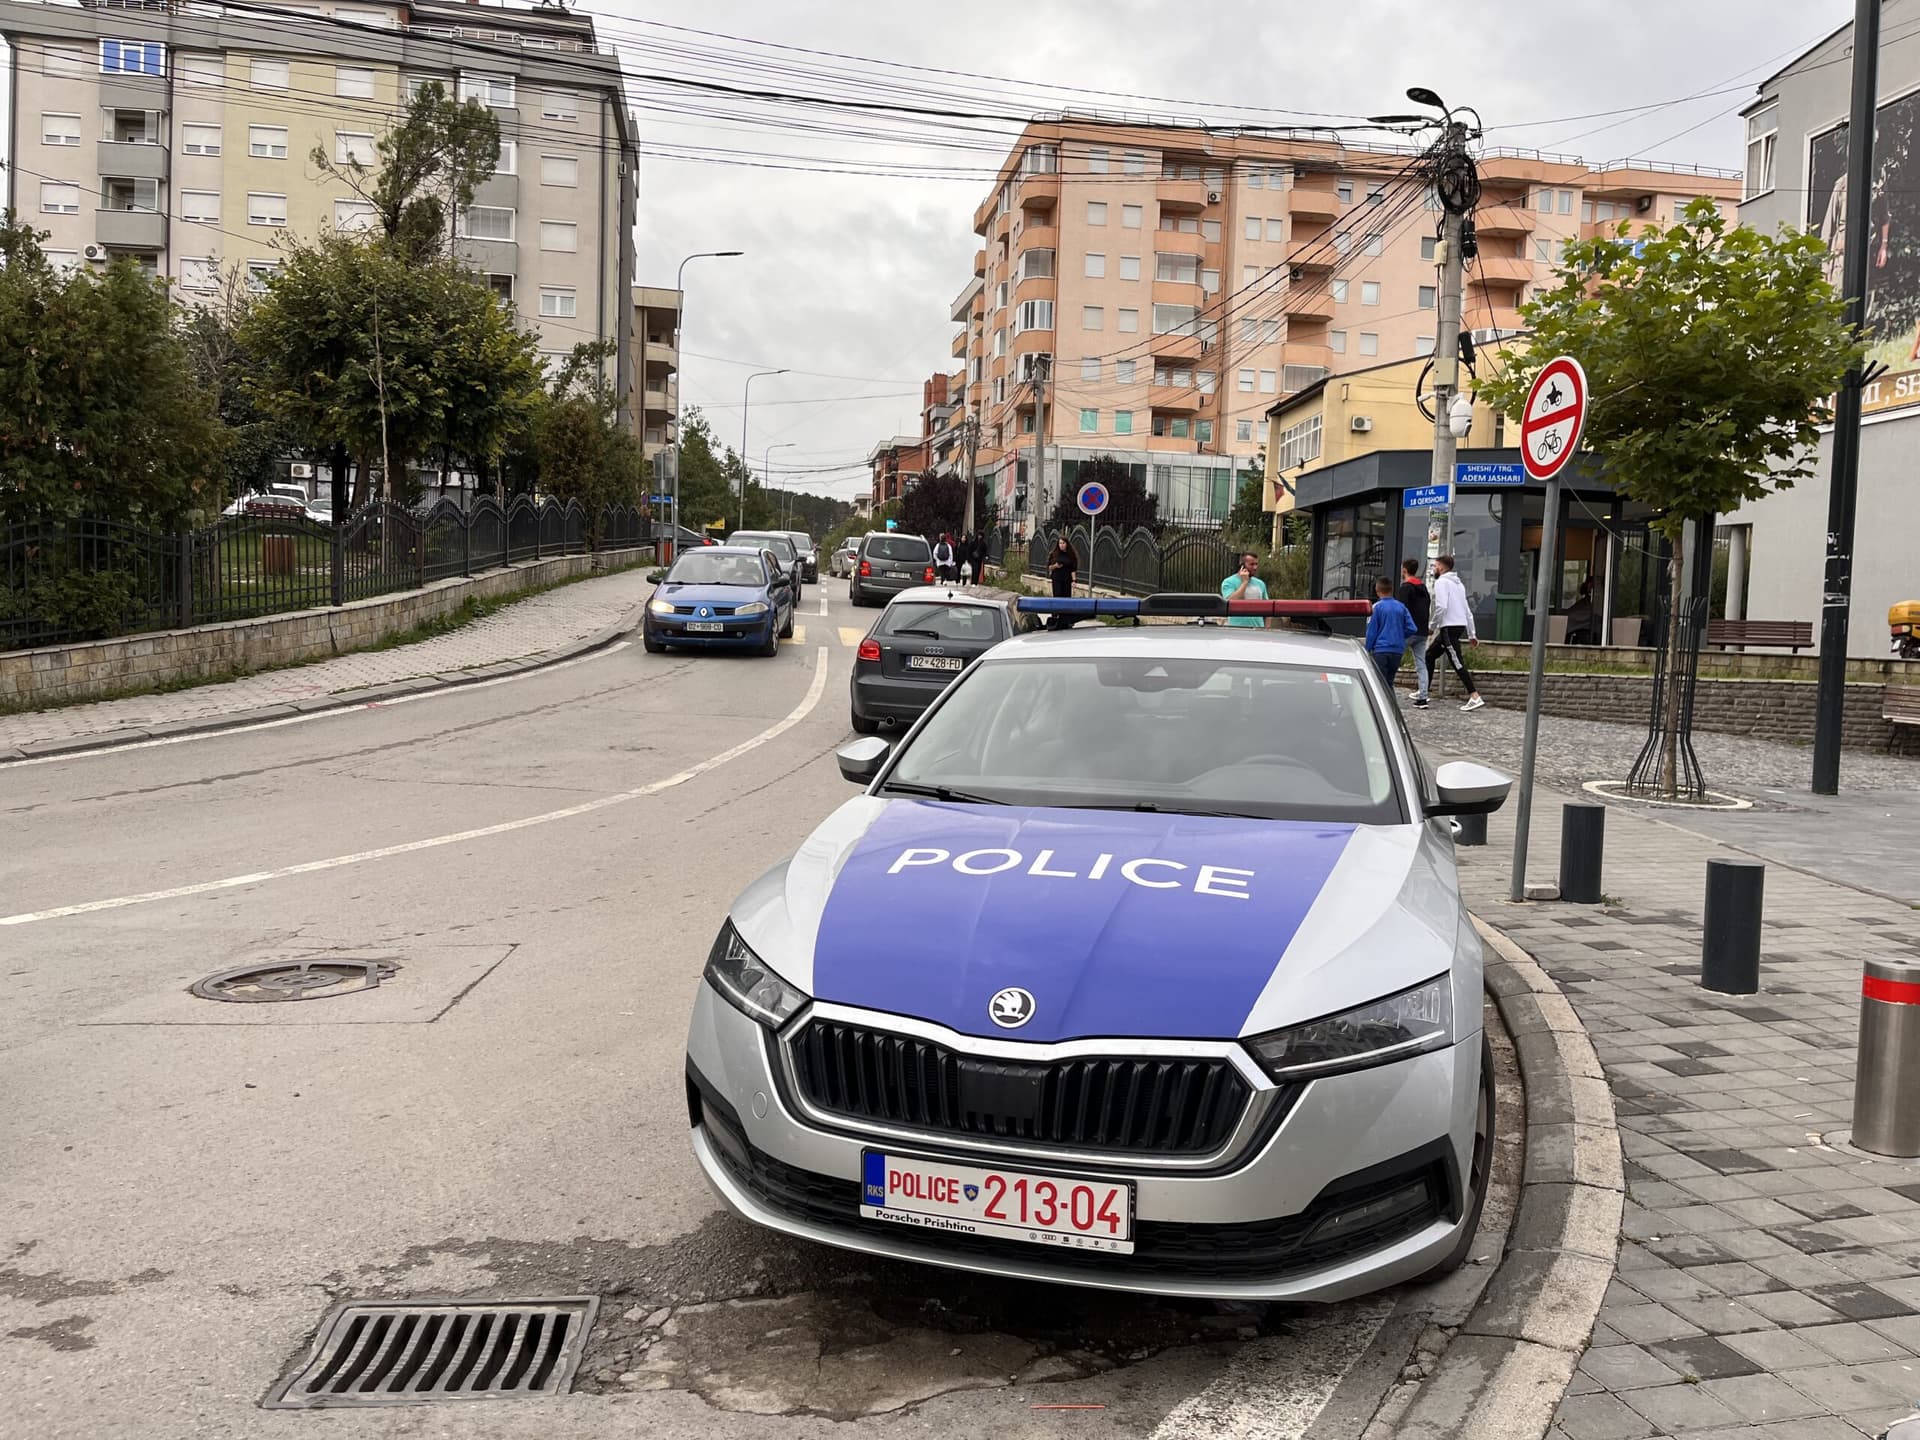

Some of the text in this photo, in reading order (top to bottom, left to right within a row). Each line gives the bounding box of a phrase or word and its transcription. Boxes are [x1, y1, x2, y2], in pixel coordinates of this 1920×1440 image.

[1467, 465, 1492, 473] SHESHI
[1498, 465, 1514, 473] TRG.
[1461, 474, 1521, 483] ADEM JASHARI
[886, 848, 1255, 900] POLICE
[867, 1184, 884, 1198] RKS
[889, 1170, 1120, 1234] POLICE 213-04
[875, 1209, 976, 1232] Porsche Prishtina
